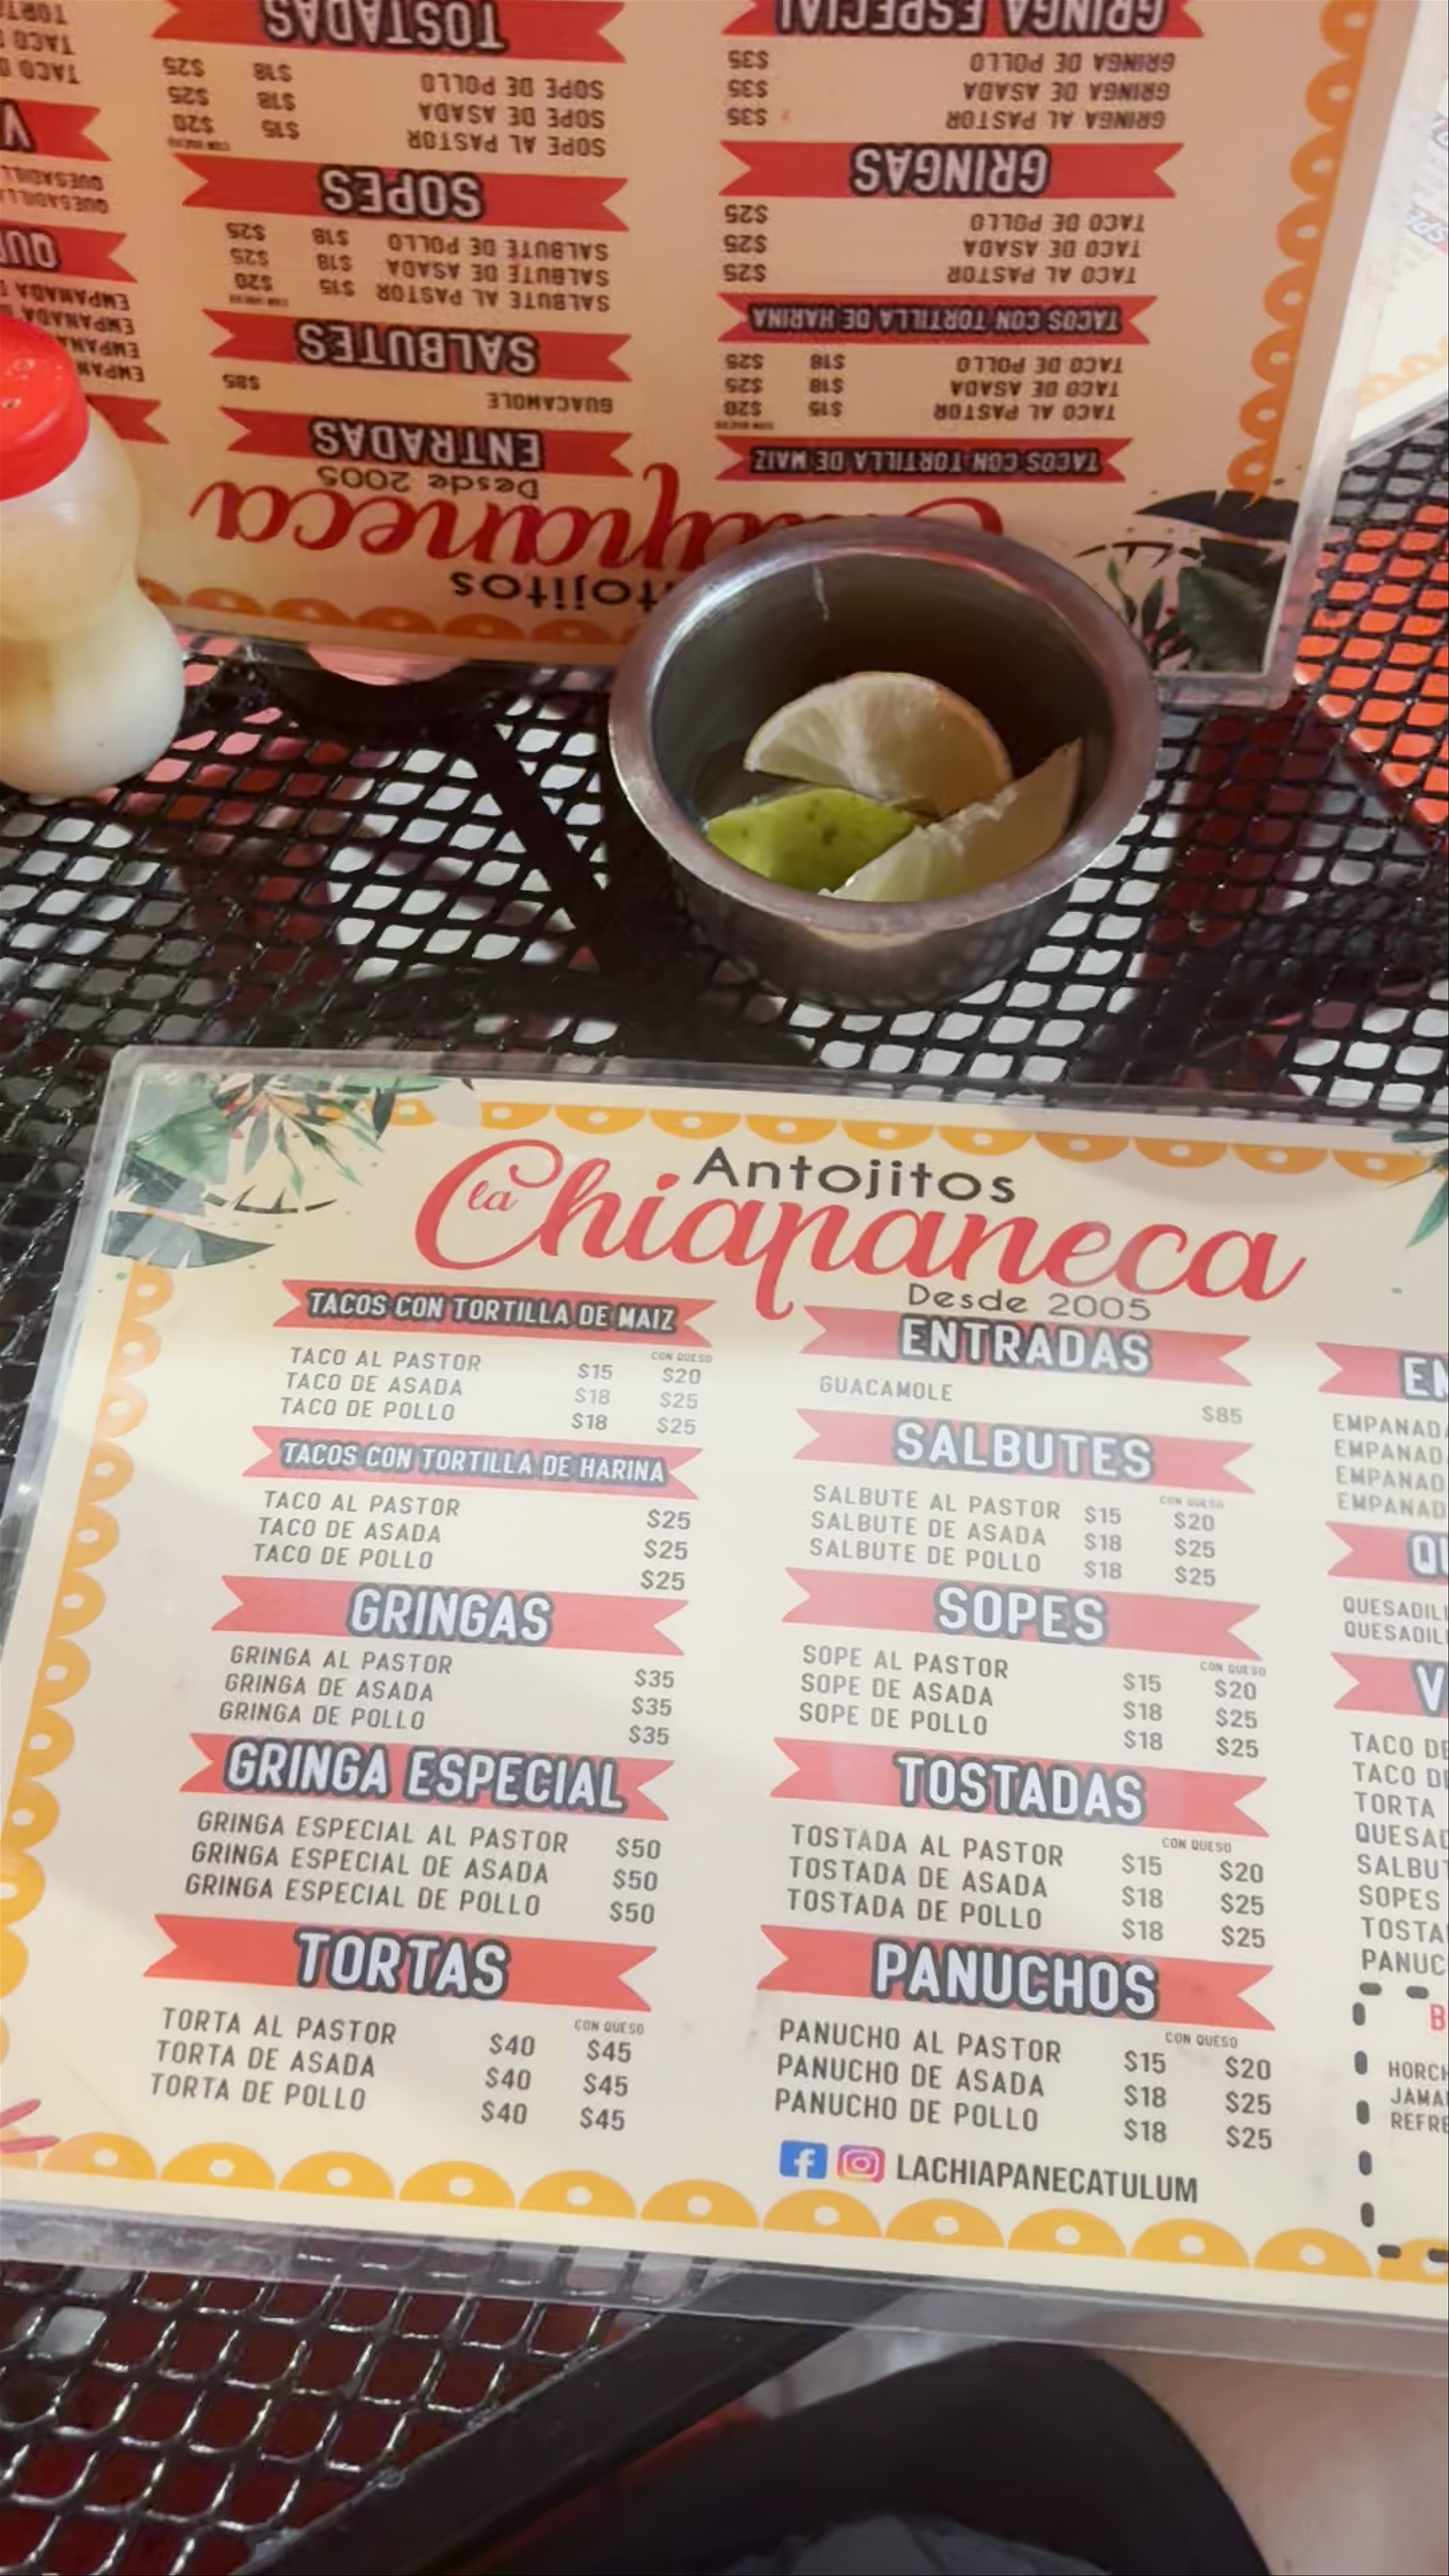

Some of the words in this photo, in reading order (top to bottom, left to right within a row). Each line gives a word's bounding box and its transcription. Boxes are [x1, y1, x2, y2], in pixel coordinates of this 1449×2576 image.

[853, 147, 1049, 195] GRINGAS
[321, 168, 482, 219] SOPES
[752, 308, 835, 329] HARINA
[843, 308, 871, 330] DE
[879, 308, 986, 331] TORTILLA
[995, 309, 1041, 331] CON
[1047, 309, 1118, 332] TACOS
[297, 322, 537, 374] SALBUTES
[311, 420, 541, 469] ENTRADAS
[754, 449, 808, 471] MAIZ
[815, 450, 844, 471] DE
[853, 450, 962, 473] TORTILLA
[972, 451, 1018, 473] CON
[1026, 451, 1098, 473] TACOS
[451, 571, 675, 614] tojitos
[468, 1180, 518, 1212] la
[693, 1147, 1015, 1204] Antojitos
[414, 1139, 1307, 1321] Chiapaneca
[311, 1292, 388, 1316] TACOS
[395, 1295, 445, 1318] CON
[453, 1297, 569, 1325] TORTILLA
[578, 1304, 609, 1327] DE
[617, 1306, 675, 1331] MAIZ
[908, 1283, 1028, 1313] Desde
[1048, 1293, 1151, 1321] 2005
[291, 1347, 346, 1366] TACO
[355, 1350, 381, 1367] AL
[393, 1351, 481, 1371] PASTOR
[577, 1363, 613, 1380] $15
[662, 1367, 701, 1384] $20
[651, 1350, 674, 1361] CON
[676, 1352, 712, 1363] QUESO
[901, 1316, 1150, 1373] ENTRADAS
[281, 1397, 337, 1416] TACO
[346, 1399, 374, 1418] DE
[383, 1401, 454, 1421] POLLO
[571, 1412, 608, 1430] $18
[657, 1416, 696, 1435] $25
[820, 1375, 952, 1402] GUACAMOLE
[1202, 1406, 1243, 1425] $85
[1333, 1413, 1448, 1439] EMPANAD
[284, 1442, 358, 1467] TACOS
[365, 1445, 413, 1469] CON
[422, 1448, 532, 1475] TORTILLA
[542, 1454, 572, 1478] DE
[579, 1456, 664, 1483] HARINA
[895, 1421, 1152, 1480] SALBUTES
[265, 1490, 321, 1510] TACO
[331, 1494, 357, 1512] AL
[369, 1495, 460, 1516] PASTOR
[647, 1509, 691, 1530] $25
[813, 1484, 918, 1509] SALBUTE
[929, 1493, 957, 1512] AL
[969, 1495, 1060, 1519] PASTOR
[1084, 1506, 1121, 1525] $15
[1174, 1512, 1215, 1532] $20
[259, 1517, 316, 1537] TACO
[326, 1520, 354, 1539] DE
[364, 1522, 440, 1543] ASADA
[644, 1538, 688, 1560] $25
[350, 1587, 552, 1643] GRINGAS
[937, 1585, 1104, 1642] SOPES
[1343, 1596, 1448, 1621] QUESADIL
[230, 1645, 311, 1667] GRINGA
[323, 1650, 349, 1669] AL
[361, 1651, 452, 1674] PASTOR
[634, 1668, 674, 1689] $35
[1200, 1661, 1223, 1672] CON
[1228, 1663, 1266, 1677] QUESO
[801, 1672, 860, 1696] SOPE
[872, 1678, 900, 1699] DE
[912, 1681, 993, 1706] ASADA
[1123, 1700, 1162, 1721] $18
[1215, 1707, 1257, 1729] $25
[219, 1701, 300, 1723] GRINGA
[312, 1705, 341, 1726] DE
[351, 1707, 425, 1730] POLLO
[629, 1725, 669, 1746] $35
[1351, 1732, 1414, 1756] TACO
[226, 1740, 388, 1795] GRINGA
[406, 1750, 624, 1810] ESPECIAL
[896, 1755, 1143, 1821] TOSTADAS
[1354, 1792, 1435, 1818] TORTA
[197, 1810, 284, 1836] GRINGA
[296, 1816, 413, 1844] ESPECIAL
[427, 1824, 455, 1846] AL
[470, 1826, 568, 1853] PASTOR
[616, 1837, 661, 1859] $50
[791, 1824, 907, 1854] TOSTADA
[920, 1835, 950, 1857] AL
[963, 1838, 1063, 1867] PASTOR
[1121, 1853, 1162, 1876] $15
[1220, 1860, 1263, 1883] $20
[1162, 1837, 1187, 1849] CON
[1191, 1839, 1232, 1853] QUESO
[185, 1873, 273, 1899] GRINGA
[285, 1878, 404, 1908] ESPECIAL
[418, 1887, 448, 1910] DE
[460, 1890, 540, 1916] POLLO
[609, 1901, 655, 1924] $50
[788, 1889, 904, 1919] TOSTADA
[917, 1899, 948, 1922] DE
[961, 1902, 1041, 1930] POLLO
[1122, 1918, 1163, 1941] $18
[1221, 1925, 1265, 1949] $25
[1359, 1884, 1440, 1911] SOPES
[1361, 1916, 1448, 1944] TOSTA
[298, 1931, 508, 1996] TORTAS
[875, 1941, 1156, 2015] PANUCHOS
[164, 2007, 240, 2034] TORTA
[254, 2015, 282, 2038] AL
[297, 2017, 396, 2045] PASTOR
[489, 2033, 535, 2056] $40
[587, 2039, 631, 2063] $45
[574, 2019, 600, 2032] CON
[604, 2021, 644, 2035] QUESO
[1165, 2032, 1191, 2045] CON
[1196, 2034, 1238, 2049] QUESO
[157, 2040, 235, 2067] TORTA
[248, 2047, 279, 2070] DE
[290, 2050, 374, 2077] ASADA
[485, 2066, 531, 2090] $40
[583, 2073, 628, 2097] $45
[780, 2018, 900, 2050] PANUCHO
[913, 2030, 943, 2054] AL
[958, 2032, 1061, 2063] PASTOR
[1124, 2050, 1166, 2074] $15
[1225, 2055, 1271, 2080] $20
[778, 2053, 898, 2085] PANUCHO
[912, 2064, 942, 2089] DE
[956, 2068, 1044, 2097] ASADA
[1124, 2084, 1166, 2108] $18
[1226, 2090, 1271, 2115] $25
[897, 2154, 1197, 2203] LACHIAPANECATULUM
